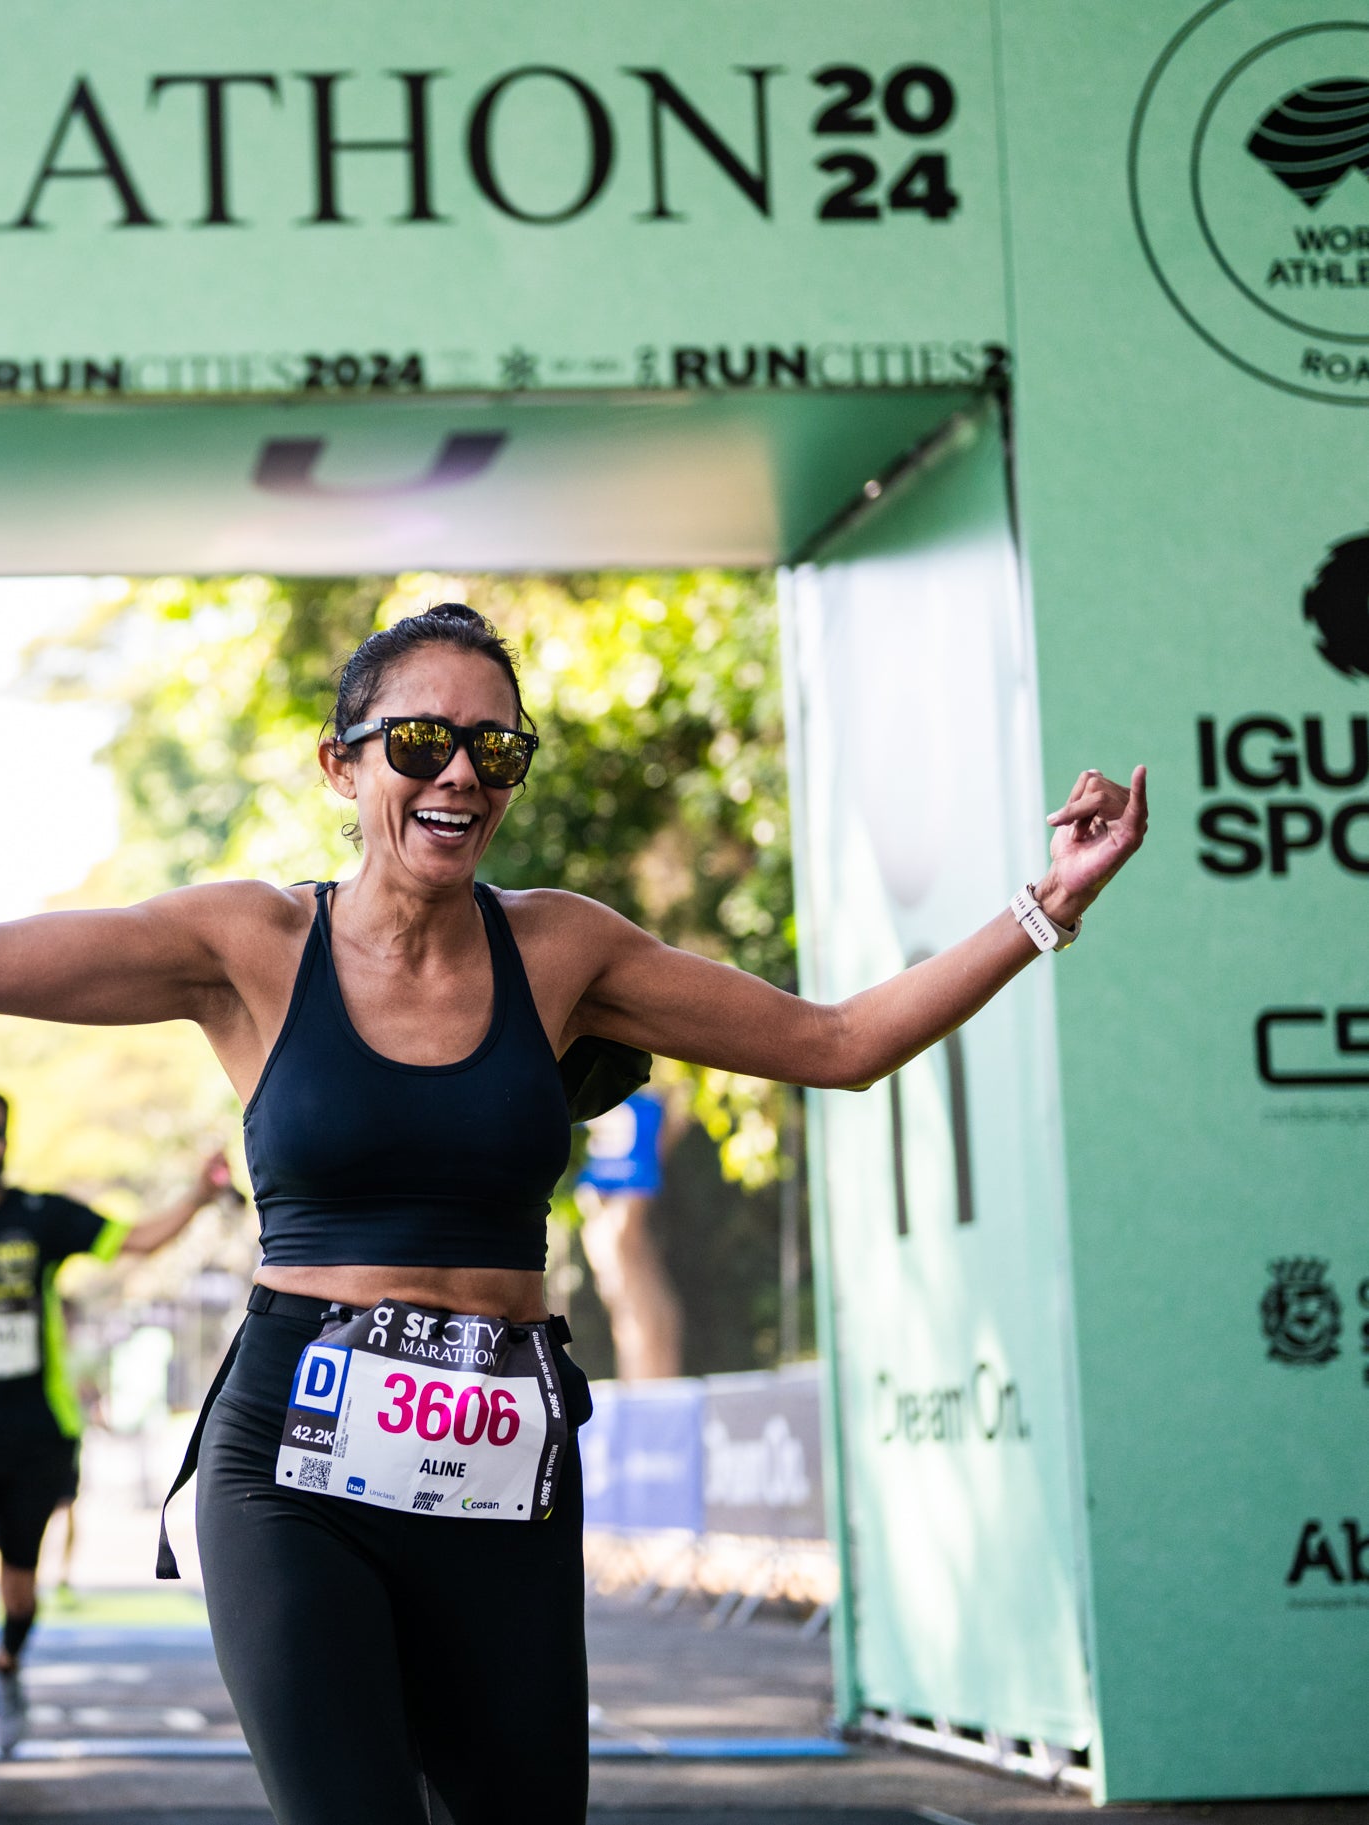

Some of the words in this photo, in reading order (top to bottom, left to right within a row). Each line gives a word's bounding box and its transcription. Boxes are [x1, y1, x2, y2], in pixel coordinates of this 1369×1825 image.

[811, 63, 956, 135] 20
[817, 151, 961, 222] 24
[1197, 713, 1369, 791] IGU
[399, 1338, 498, 1367] MARATHON
[304, 1356, 336, 1397] D
[532, 1331, 554, 1390] GUARDA-VOLUME
[548, 1392, 561, 1419] 3606
[377, 1373, 520, 1446] 3606
[291, 1424, 335, 1446] 42.2K
[419, 1458, 467, 1478] ALINE
[545, 1444, 559, 1477] MEDALHA
[369, 1489, 395, 1500] Uniclass
[414, 1490, 444, 1503] amino
[540, 1480, 552, 1507] 3606
